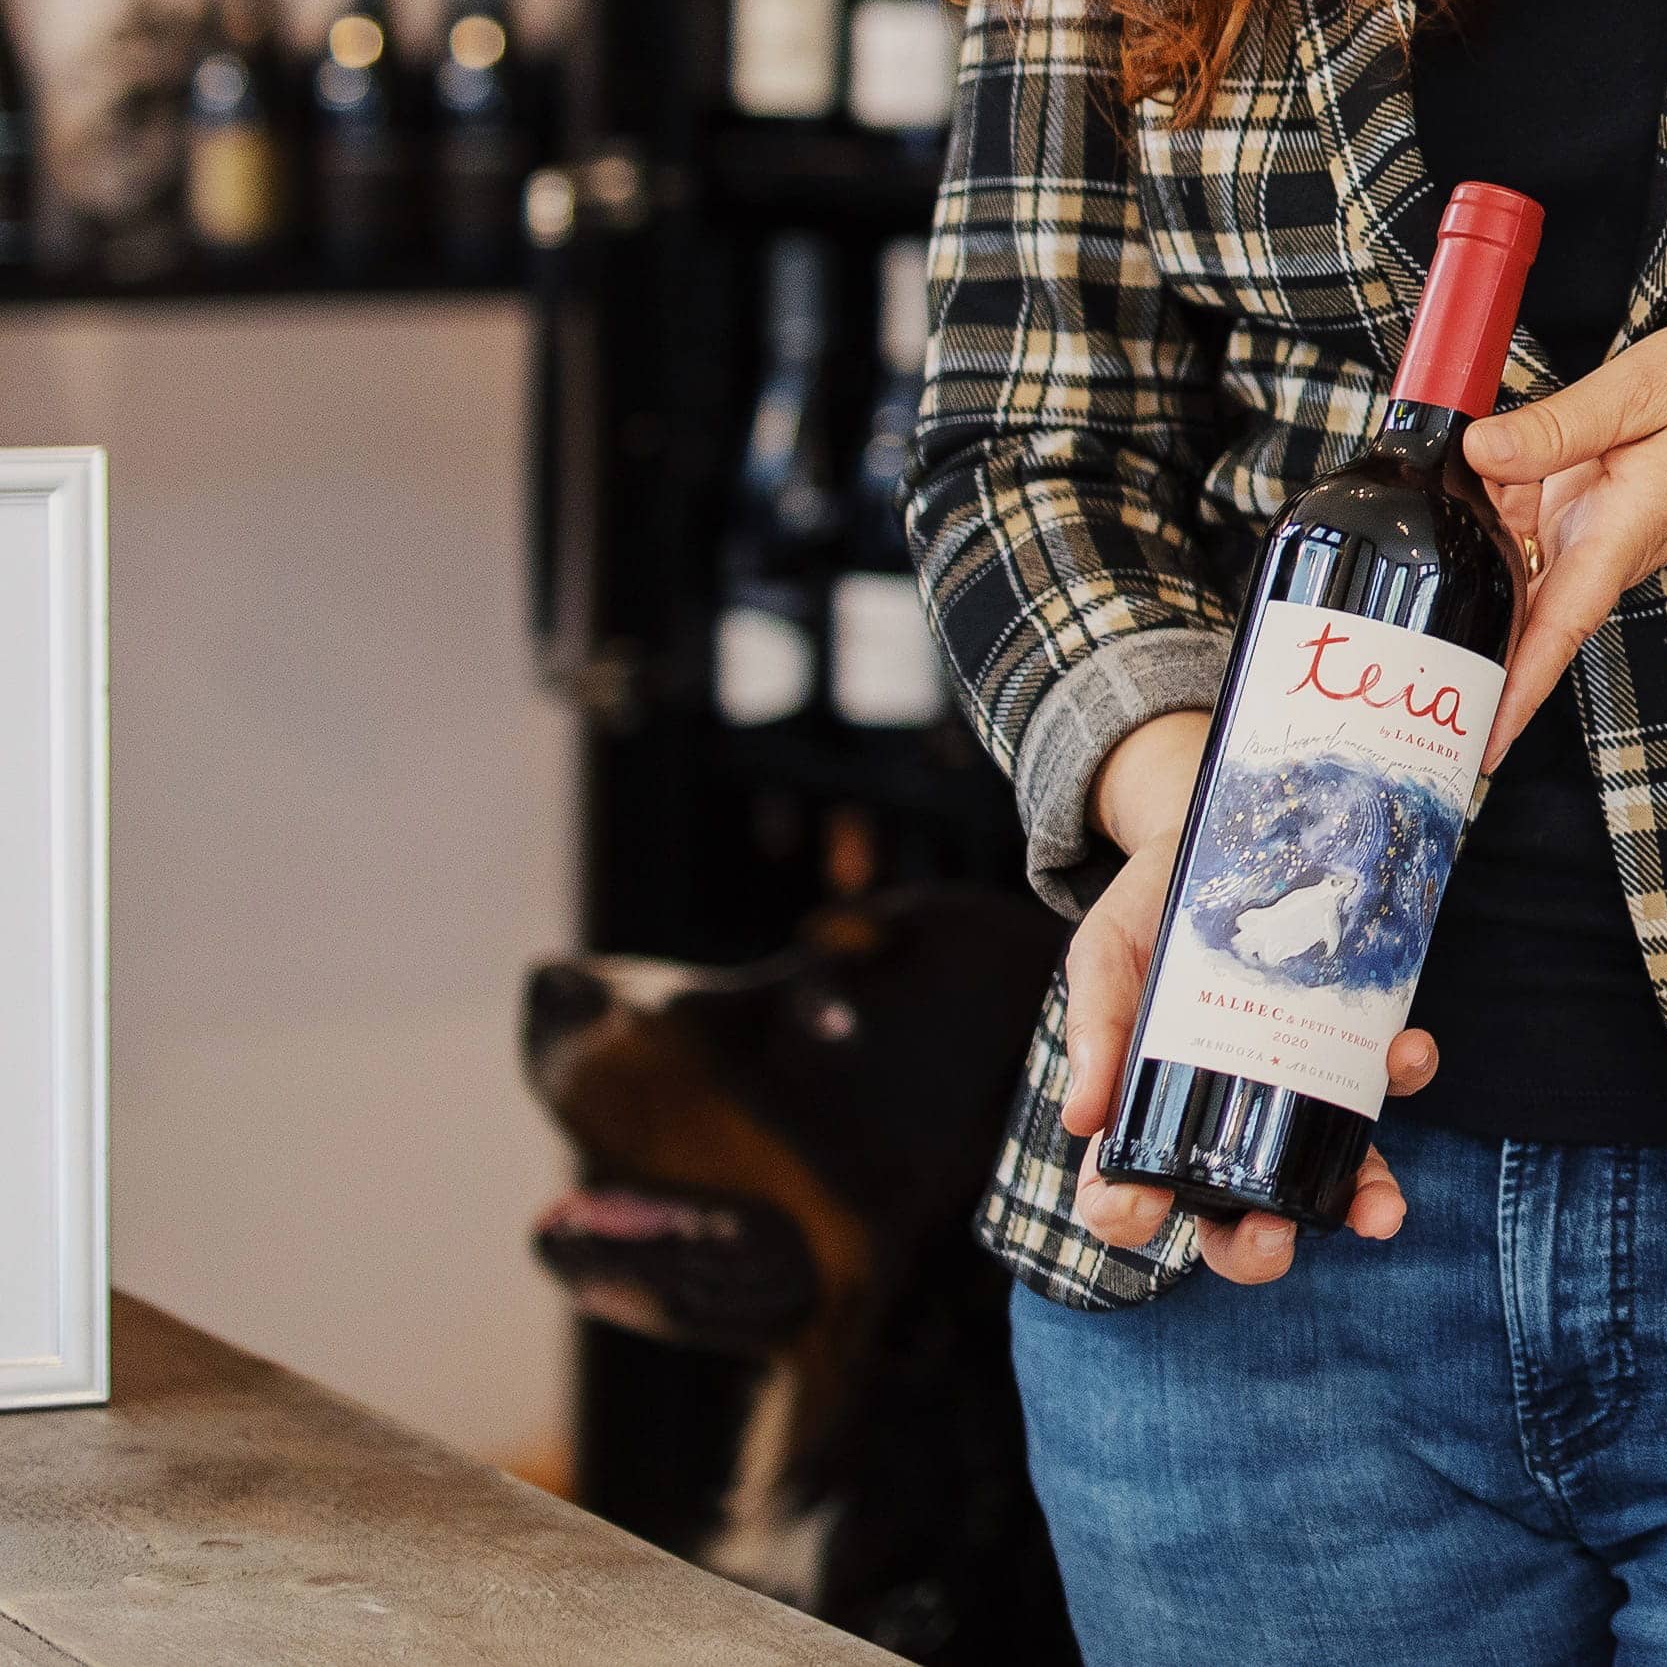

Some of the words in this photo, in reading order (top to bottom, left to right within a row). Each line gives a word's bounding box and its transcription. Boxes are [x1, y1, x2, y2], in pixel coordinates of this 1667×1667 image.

[1286, 622, 1467, 737] teia
[1394, 729, 1462, 763] LAGARDE
[1198, 990, 1284, 1021] MALBEC
[1300, 1018, 1337, 1036] PETIT
[1340, 1030, 1379, 1053] VERDOT
[1272, 1031, 1309, 1050] 2020
[1189, 1037, 1264, 1062] MENDOZA
[1286, 1062, 1360, 1092] ARGENTINA
